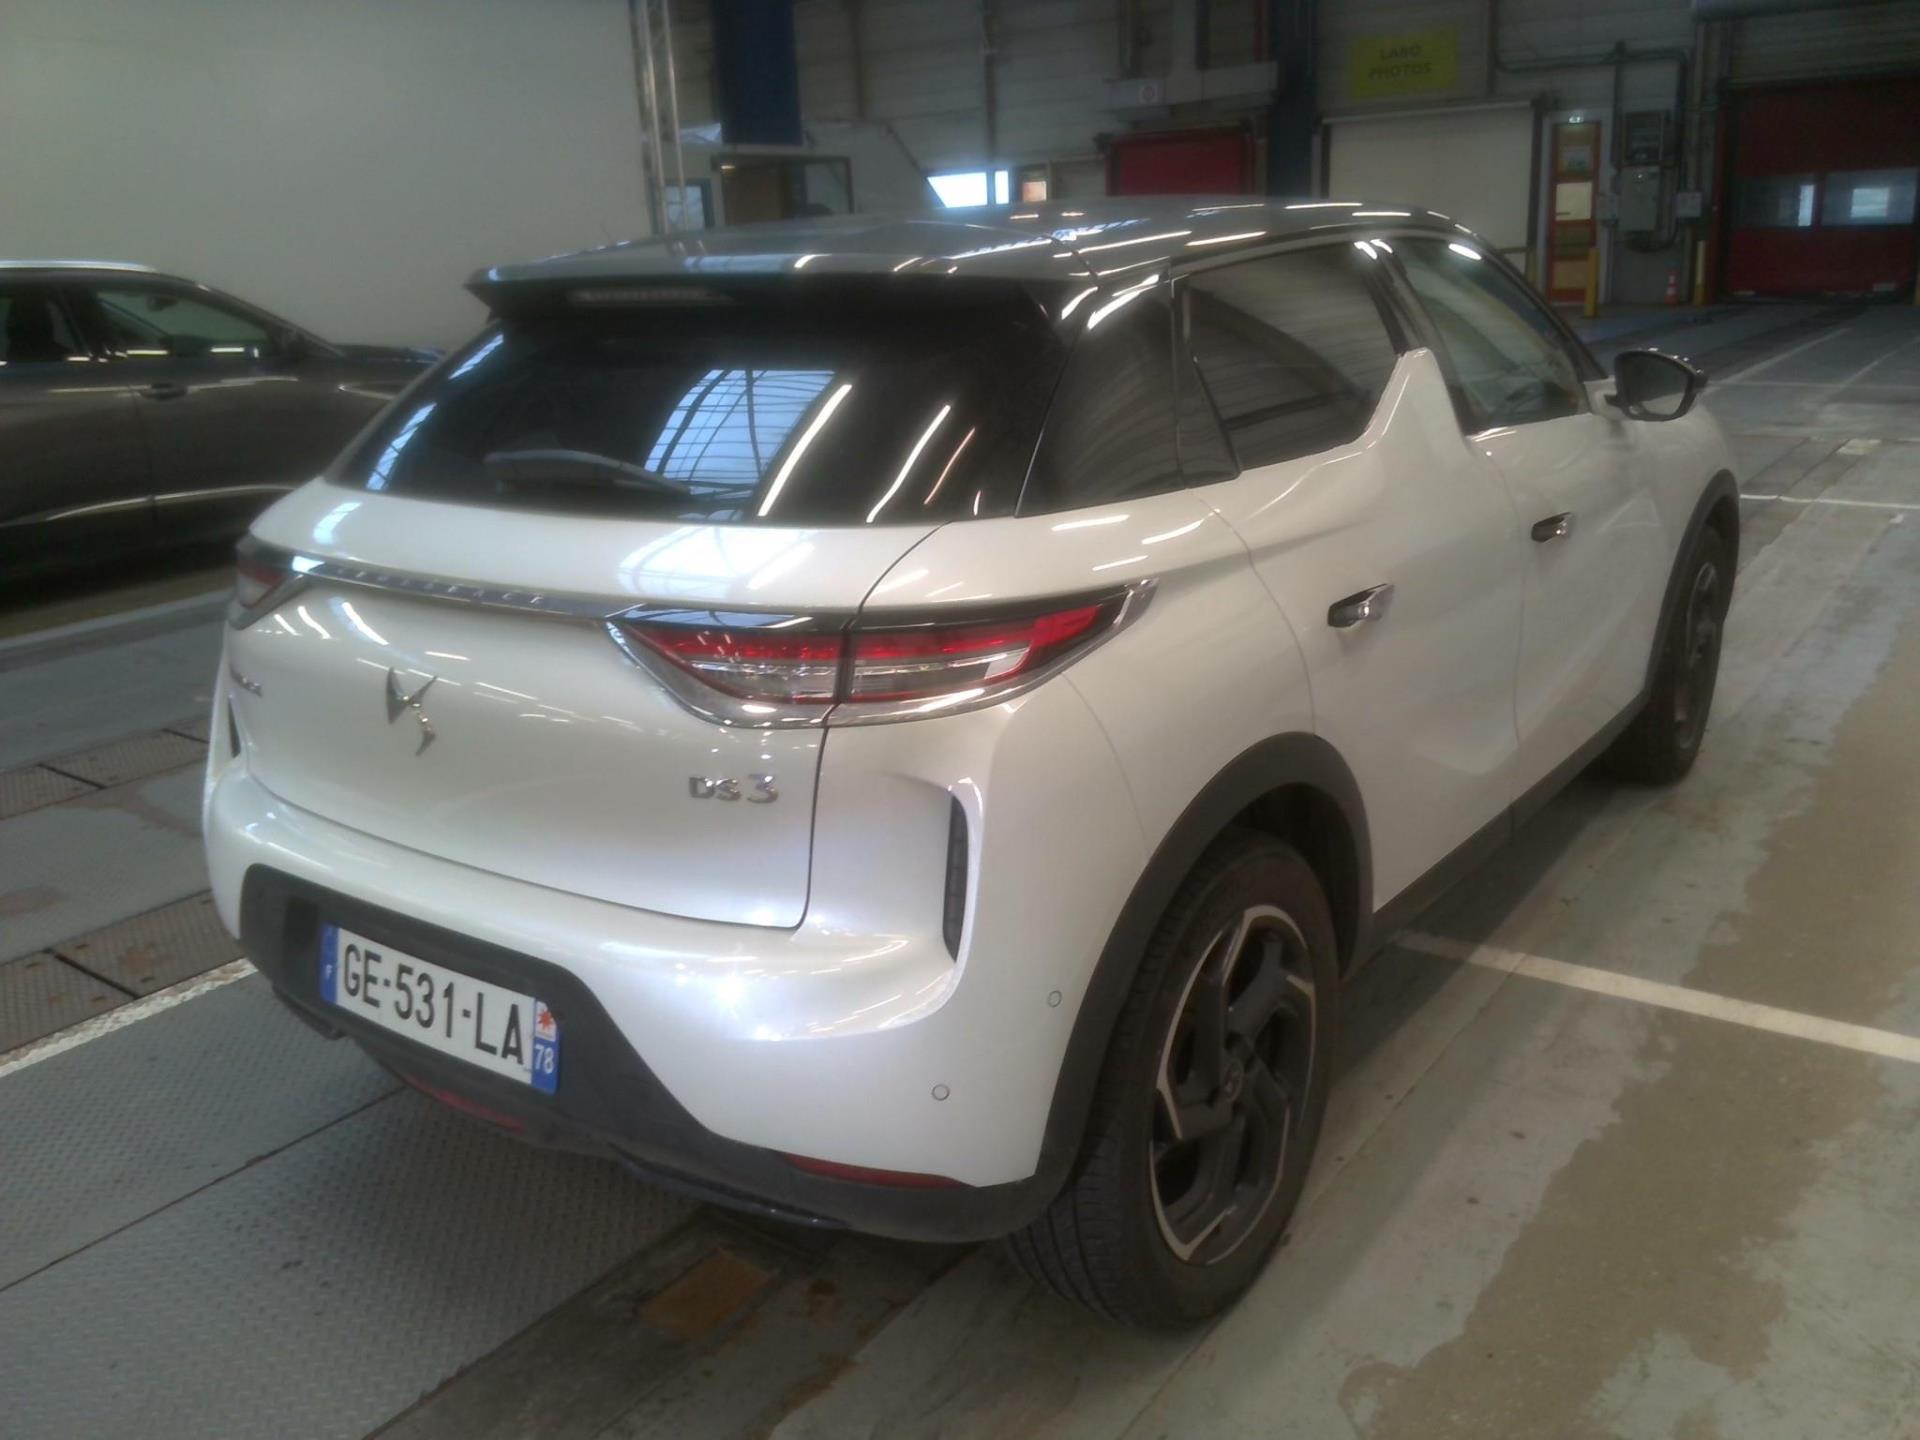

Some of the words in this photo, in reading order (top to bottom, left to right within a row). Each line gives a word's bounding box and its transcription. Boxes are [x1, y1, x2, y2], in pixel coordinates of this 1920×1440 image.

[1367, 61, 1433, 79] PHOTOS
[343, 943, 524, 1066] GE-531-LA
[535, 1043, 555, 1074] 78
